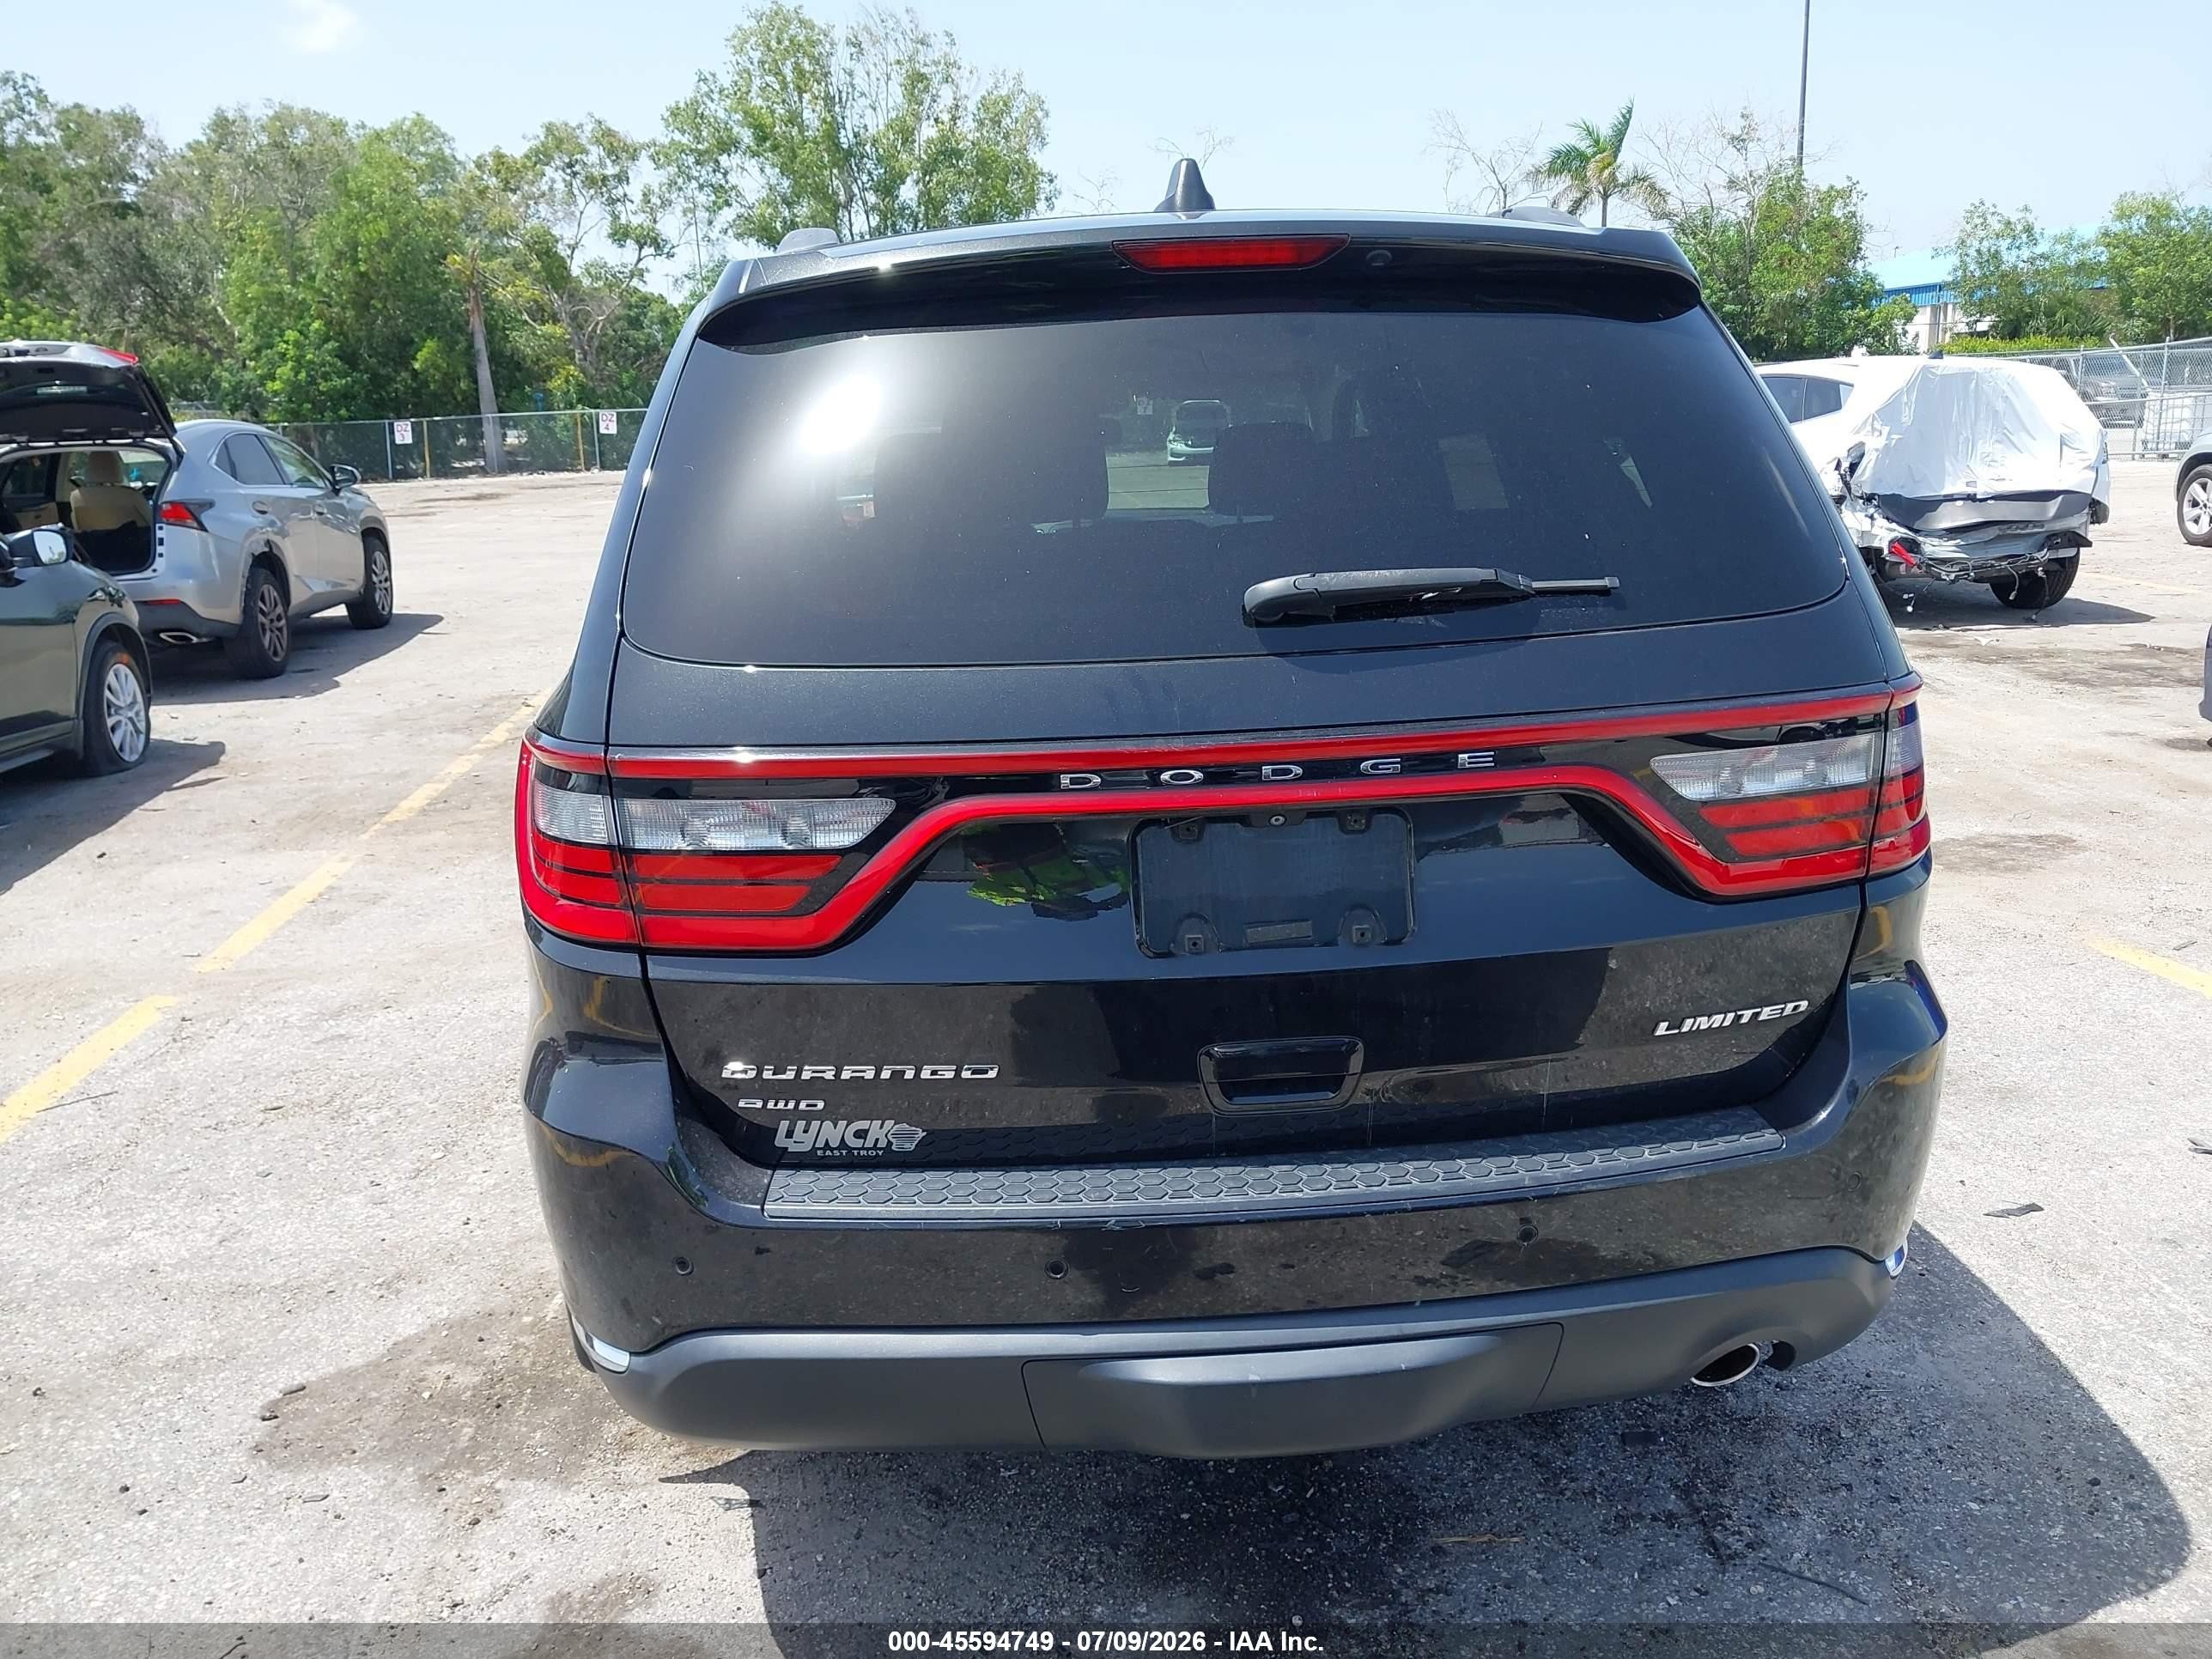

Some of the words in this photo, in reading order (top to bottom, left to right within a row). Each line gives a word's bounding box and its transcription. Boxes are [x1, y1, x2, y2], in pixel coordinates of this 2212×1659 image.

[601, 412, 615, 422] DZ
[396, 423, 410, 433] DZ
[1060, 751, 1495, 790] DODGE
[1652, 1000, 1809, 1036] LIMITED
[721, 1062, 1000, 1080] DURANGO
[738, 1098, 825, 1111] AWD
